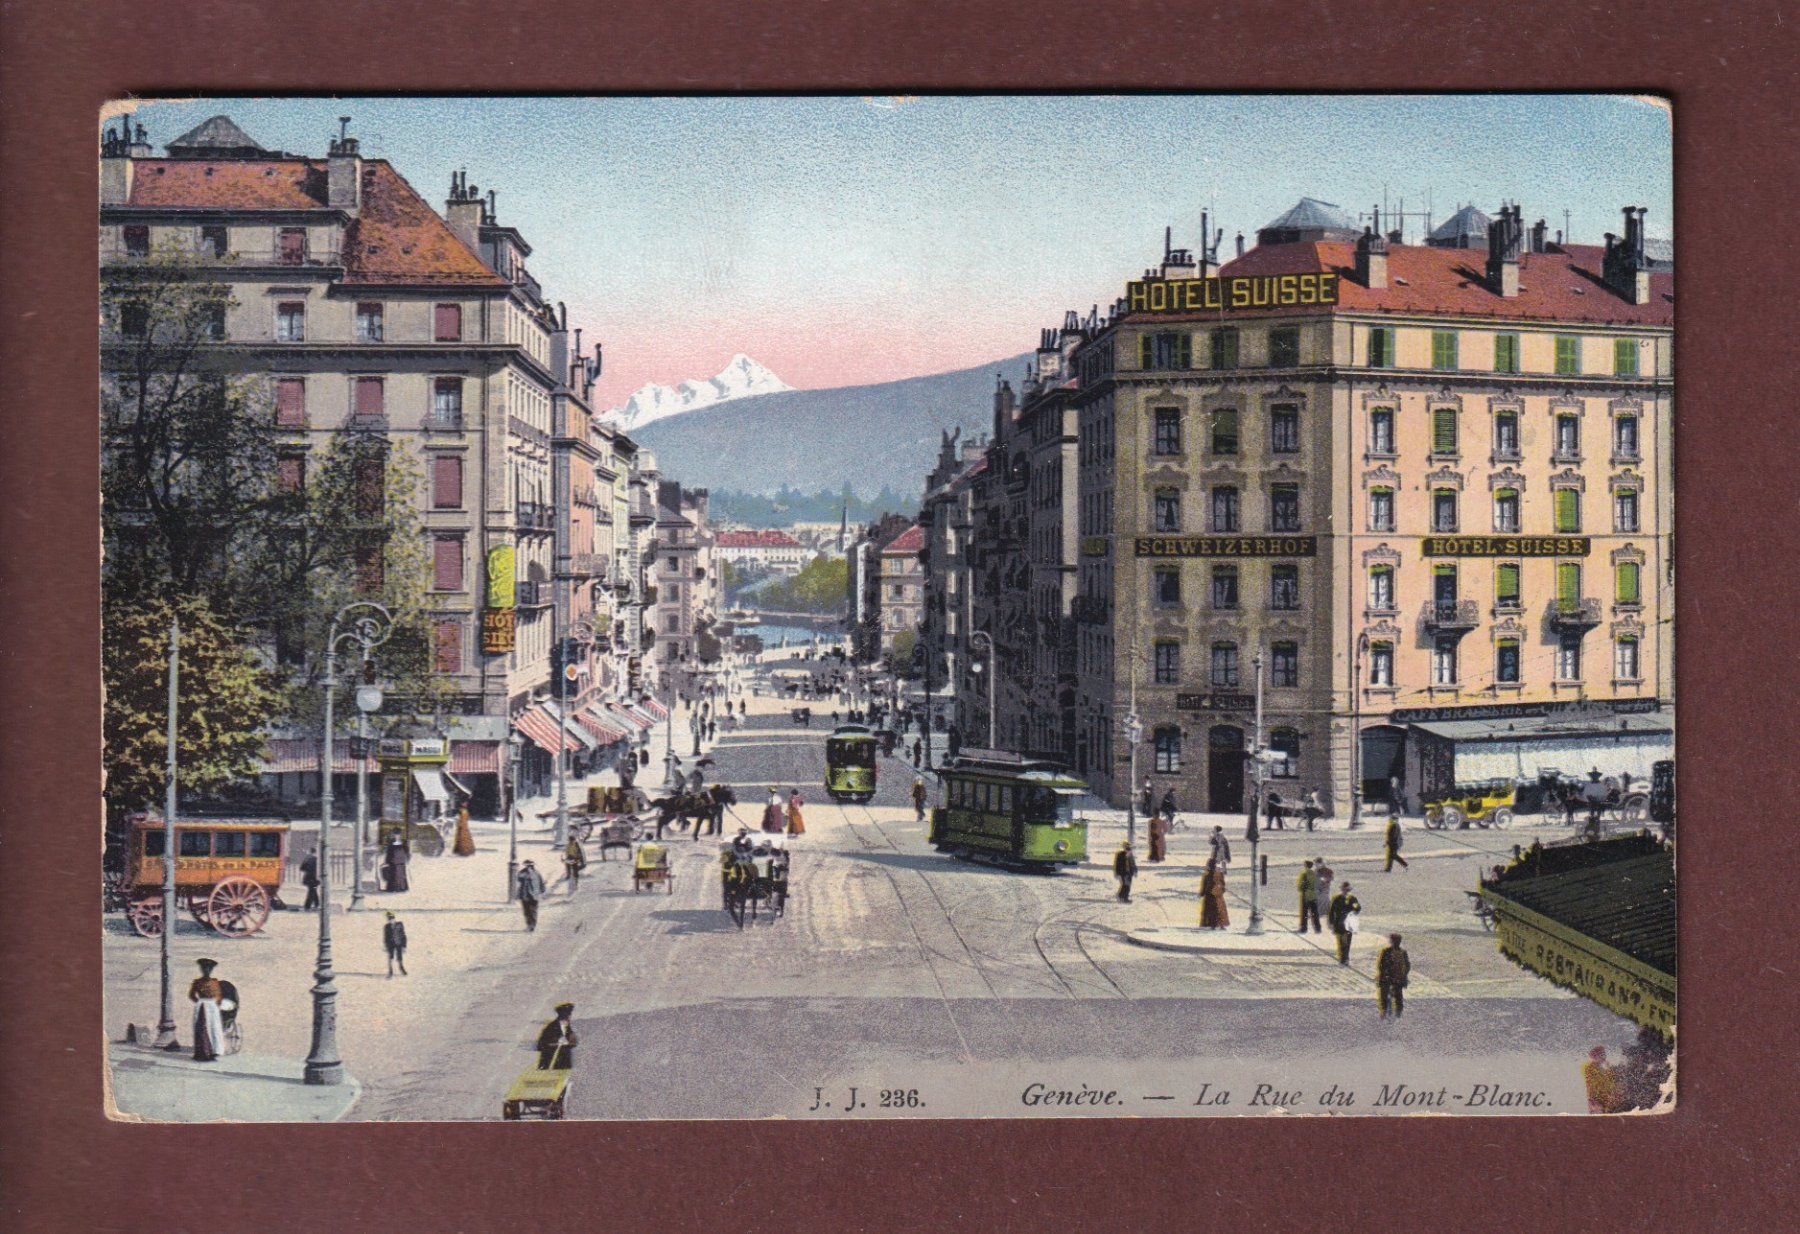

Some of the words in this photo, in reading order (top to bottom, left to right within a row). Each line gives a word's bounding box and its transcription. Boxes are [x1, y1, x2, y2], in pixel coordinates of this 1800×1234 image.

[1131, 280, 1221, 311] HOTEL
[1231, 273, 1336, 307] SUISSE
[1138, 538, 1311, 555] SCHWEIZERHOF
[1504, 537, 1583, 554] SUISSE
